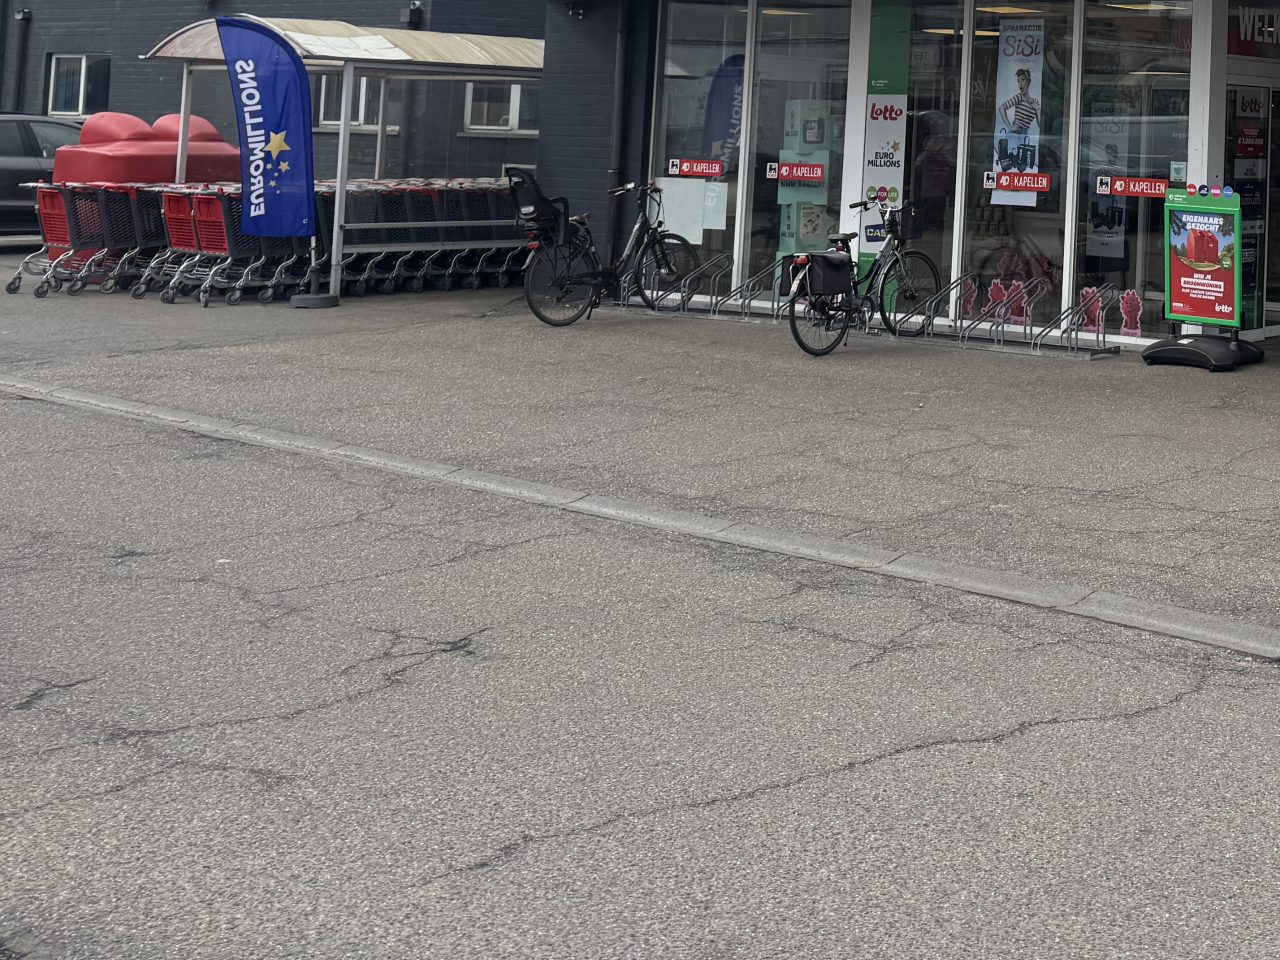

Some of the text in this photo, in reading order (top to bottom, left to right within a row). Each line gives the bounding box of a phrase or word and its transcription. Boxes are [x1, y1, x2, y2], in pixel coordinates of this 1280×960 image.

[874, 151, 894, 160] EURO
[693, 162, 720, 173] KAPELLEN
[867, 159, 901, 168] MILLIONS
[793, 166, 822, 177] KAPELLEN
[1014, 176, 1047, 188] KAPELLEN
[1129, 181, 1166, 194] KAPELLEN
[1182, 214, 1224, 225] EIGENAARS
[1186, 222, 1220, 232] GEZOCHT
